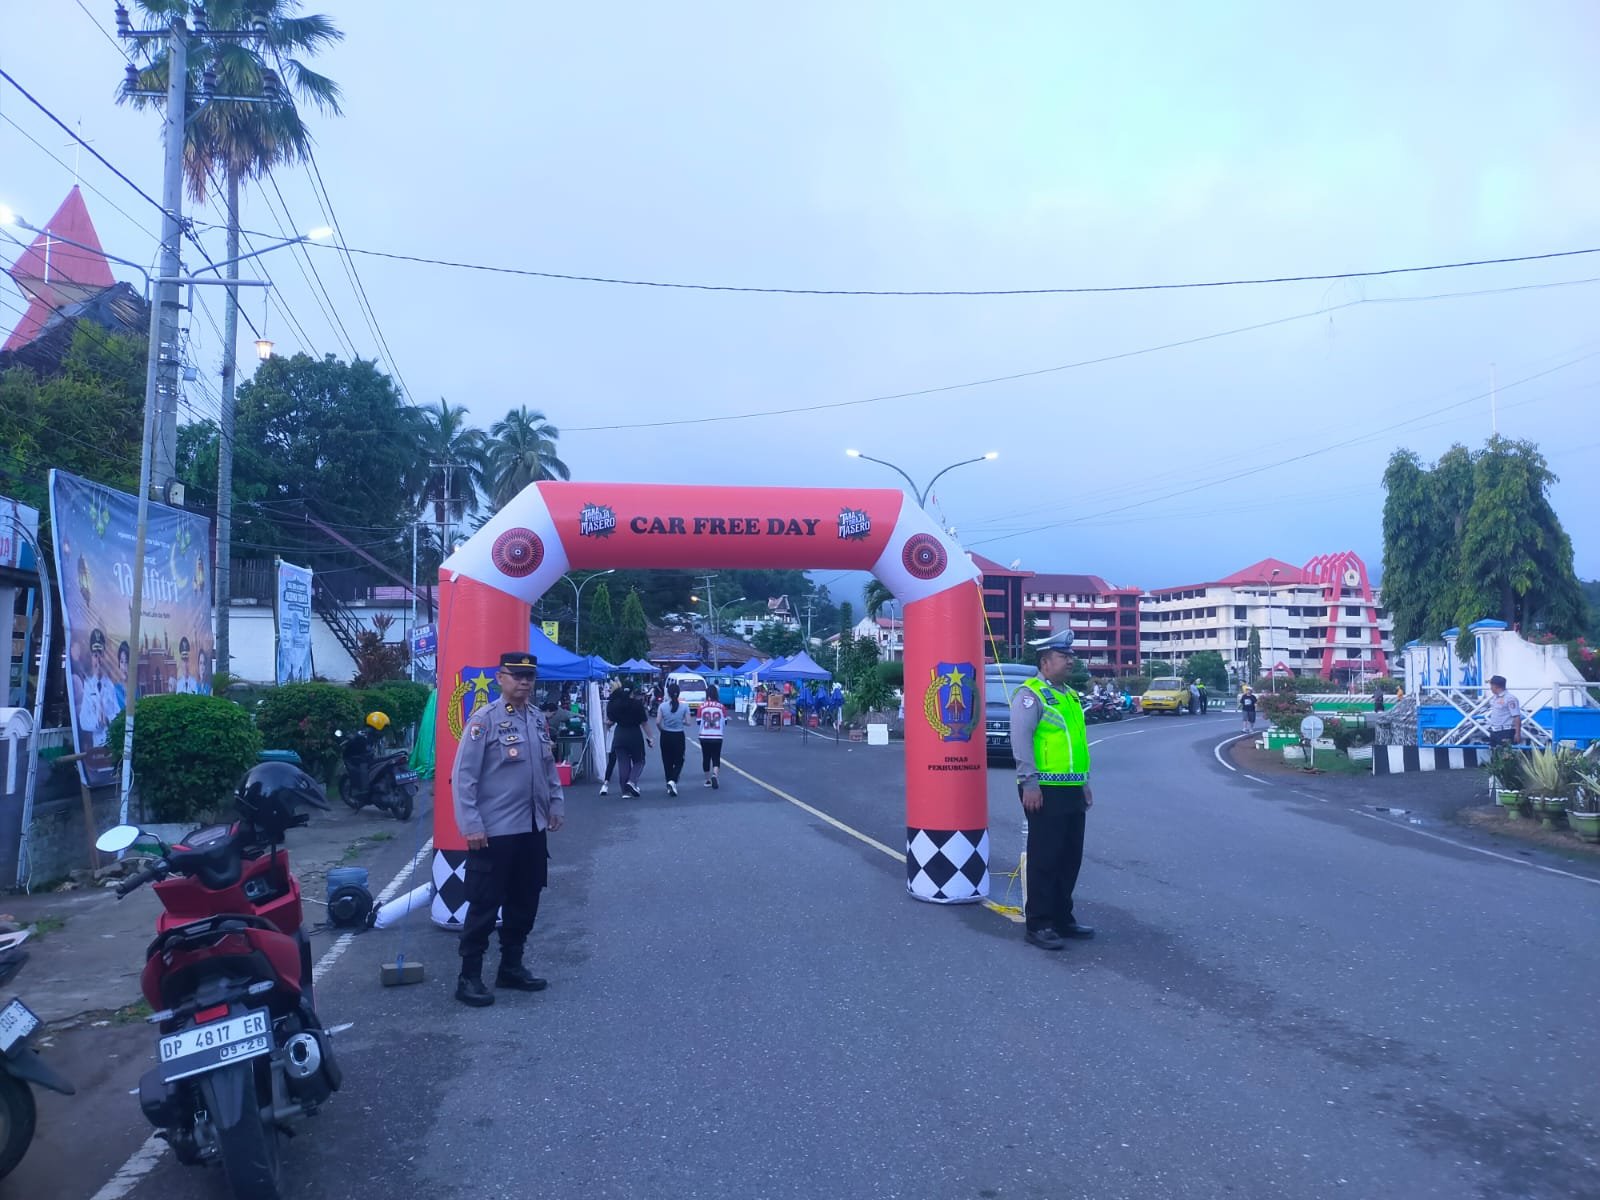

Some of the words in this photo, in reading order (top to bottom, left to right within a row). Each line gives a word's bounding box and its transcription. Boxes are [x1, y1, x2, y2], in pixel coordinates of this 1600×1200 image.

[581, 517, 616, 535] MASERO
[630, 516, 687, 535] CAR
[693, 517, 761, 536] FREE
[766, 518, 821, 536] DAY
[838, 521, 871, 538] MASERO
[163, 1040, 183, 1059] DP
[195, 1025, 230, 1048] 4817
[243, 1016, 263, 1035] ER
